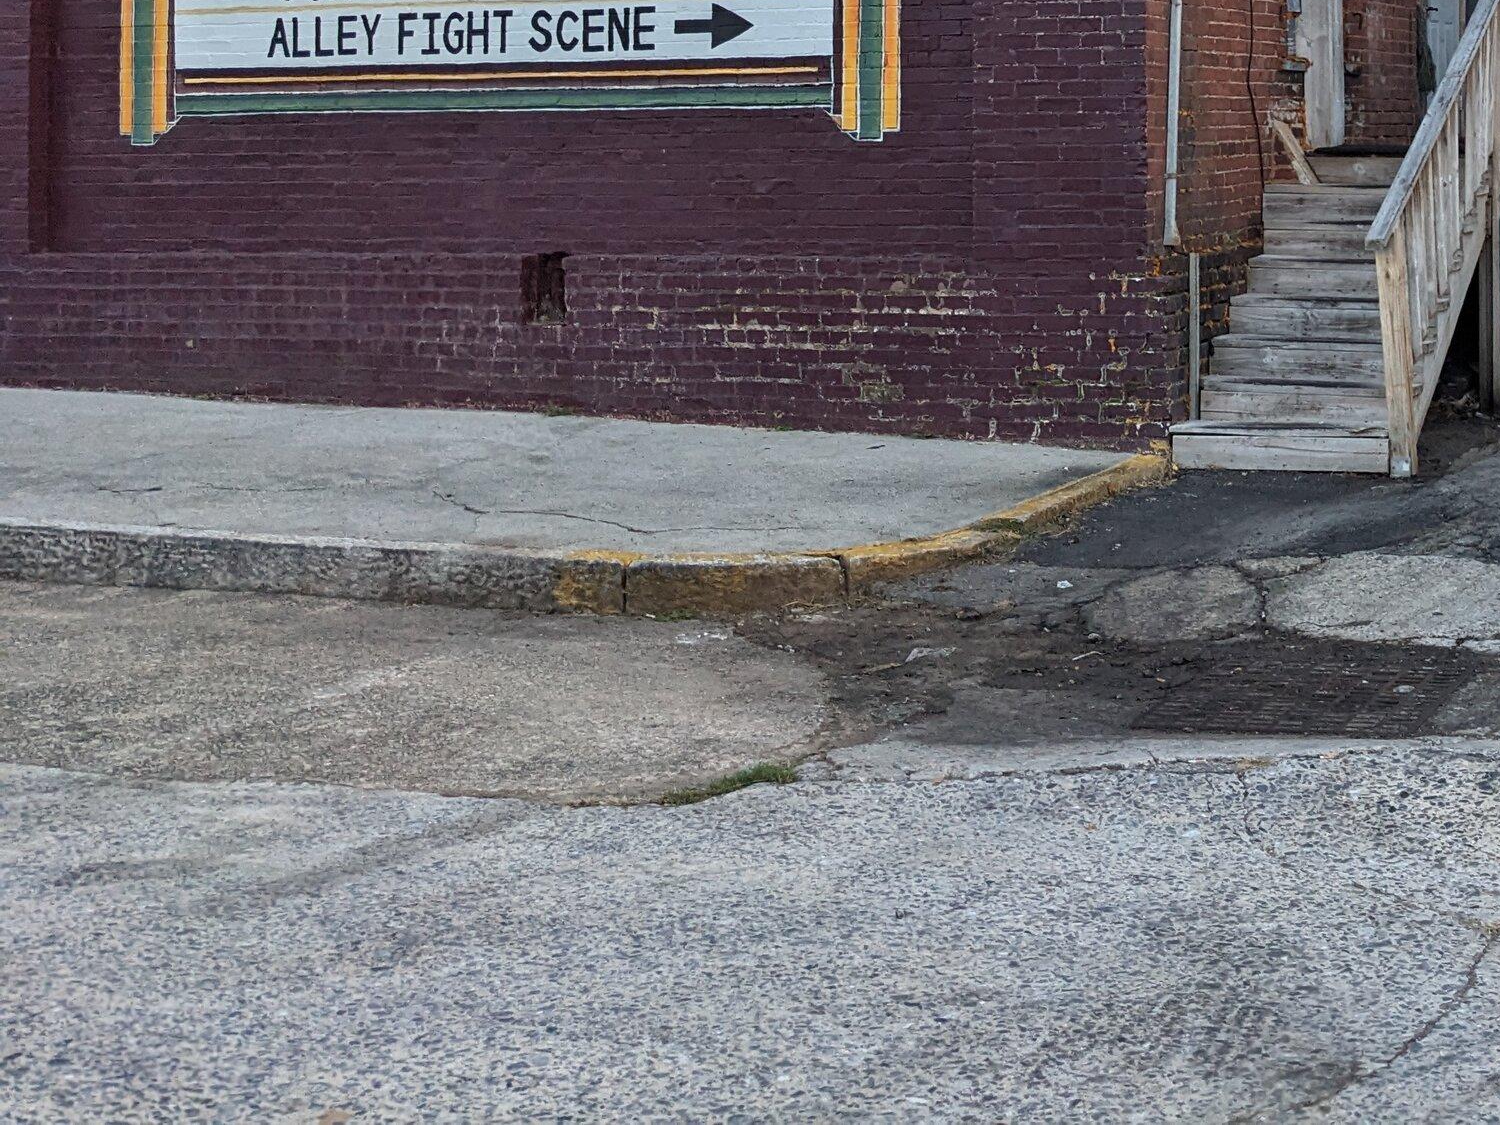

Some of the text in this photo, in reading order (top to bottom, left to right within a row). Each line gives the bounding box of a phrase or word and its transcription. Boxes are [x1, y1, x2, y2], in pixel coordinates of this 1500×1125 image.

[267, 5, 656, 58] ALLEY FIGHT SCENE
